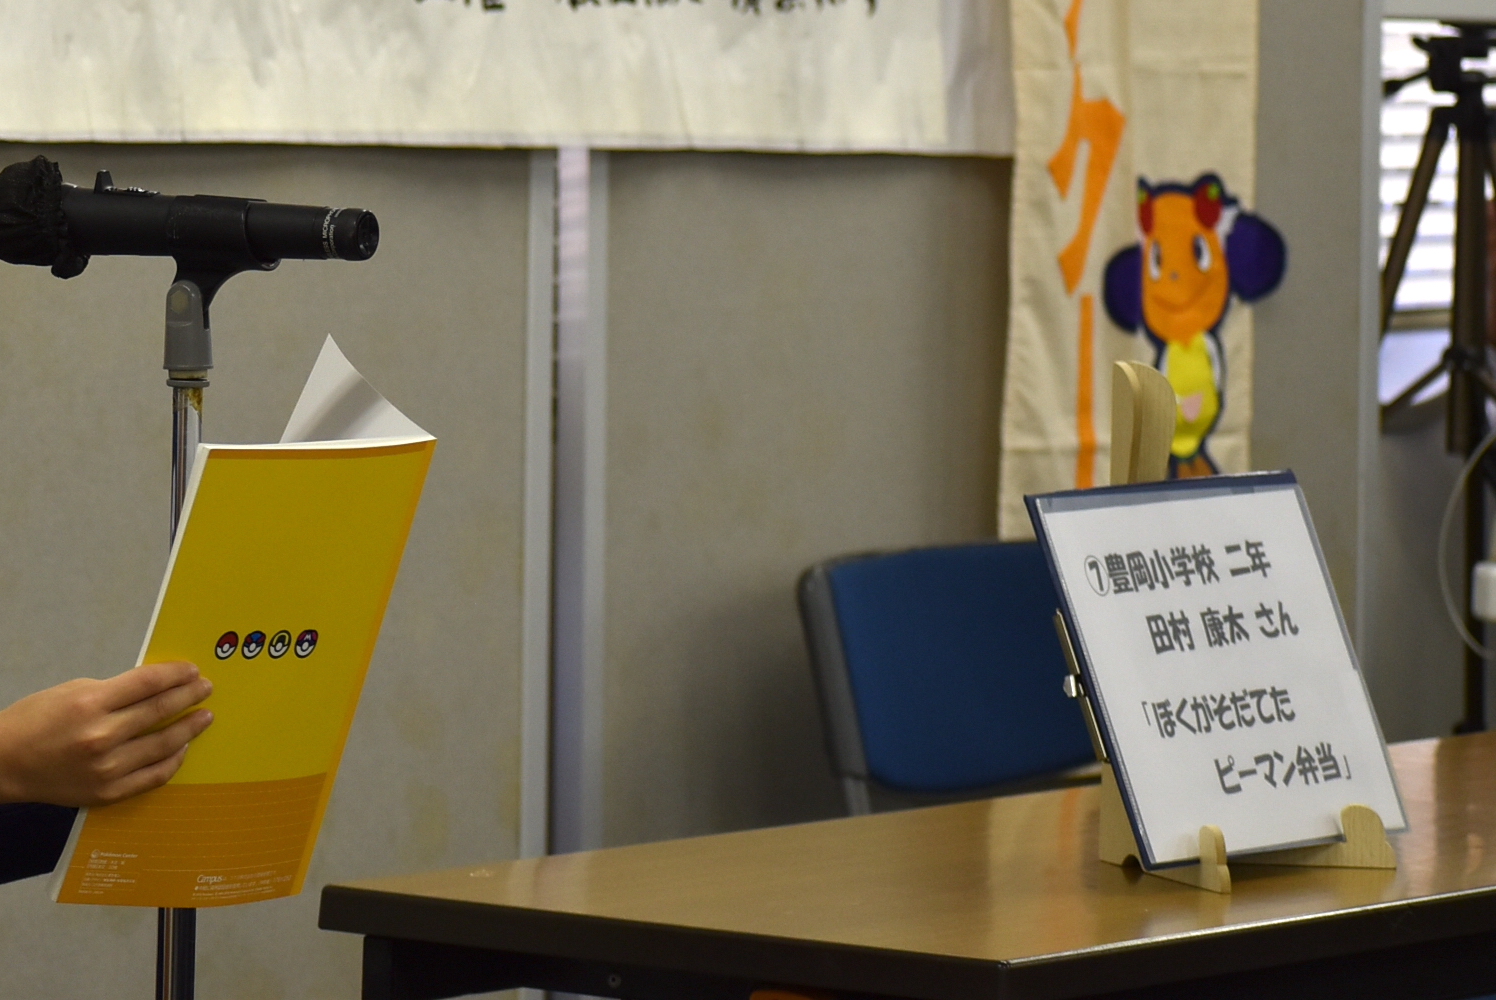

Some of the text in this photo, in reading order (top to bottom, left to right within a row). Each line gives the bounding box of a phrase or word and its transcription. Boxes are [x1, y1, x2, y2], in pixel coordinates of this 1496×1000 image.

[1224, 539, 1272, 578] 二年
[1145, 600, 1300, 655] 田村 康太 さん
